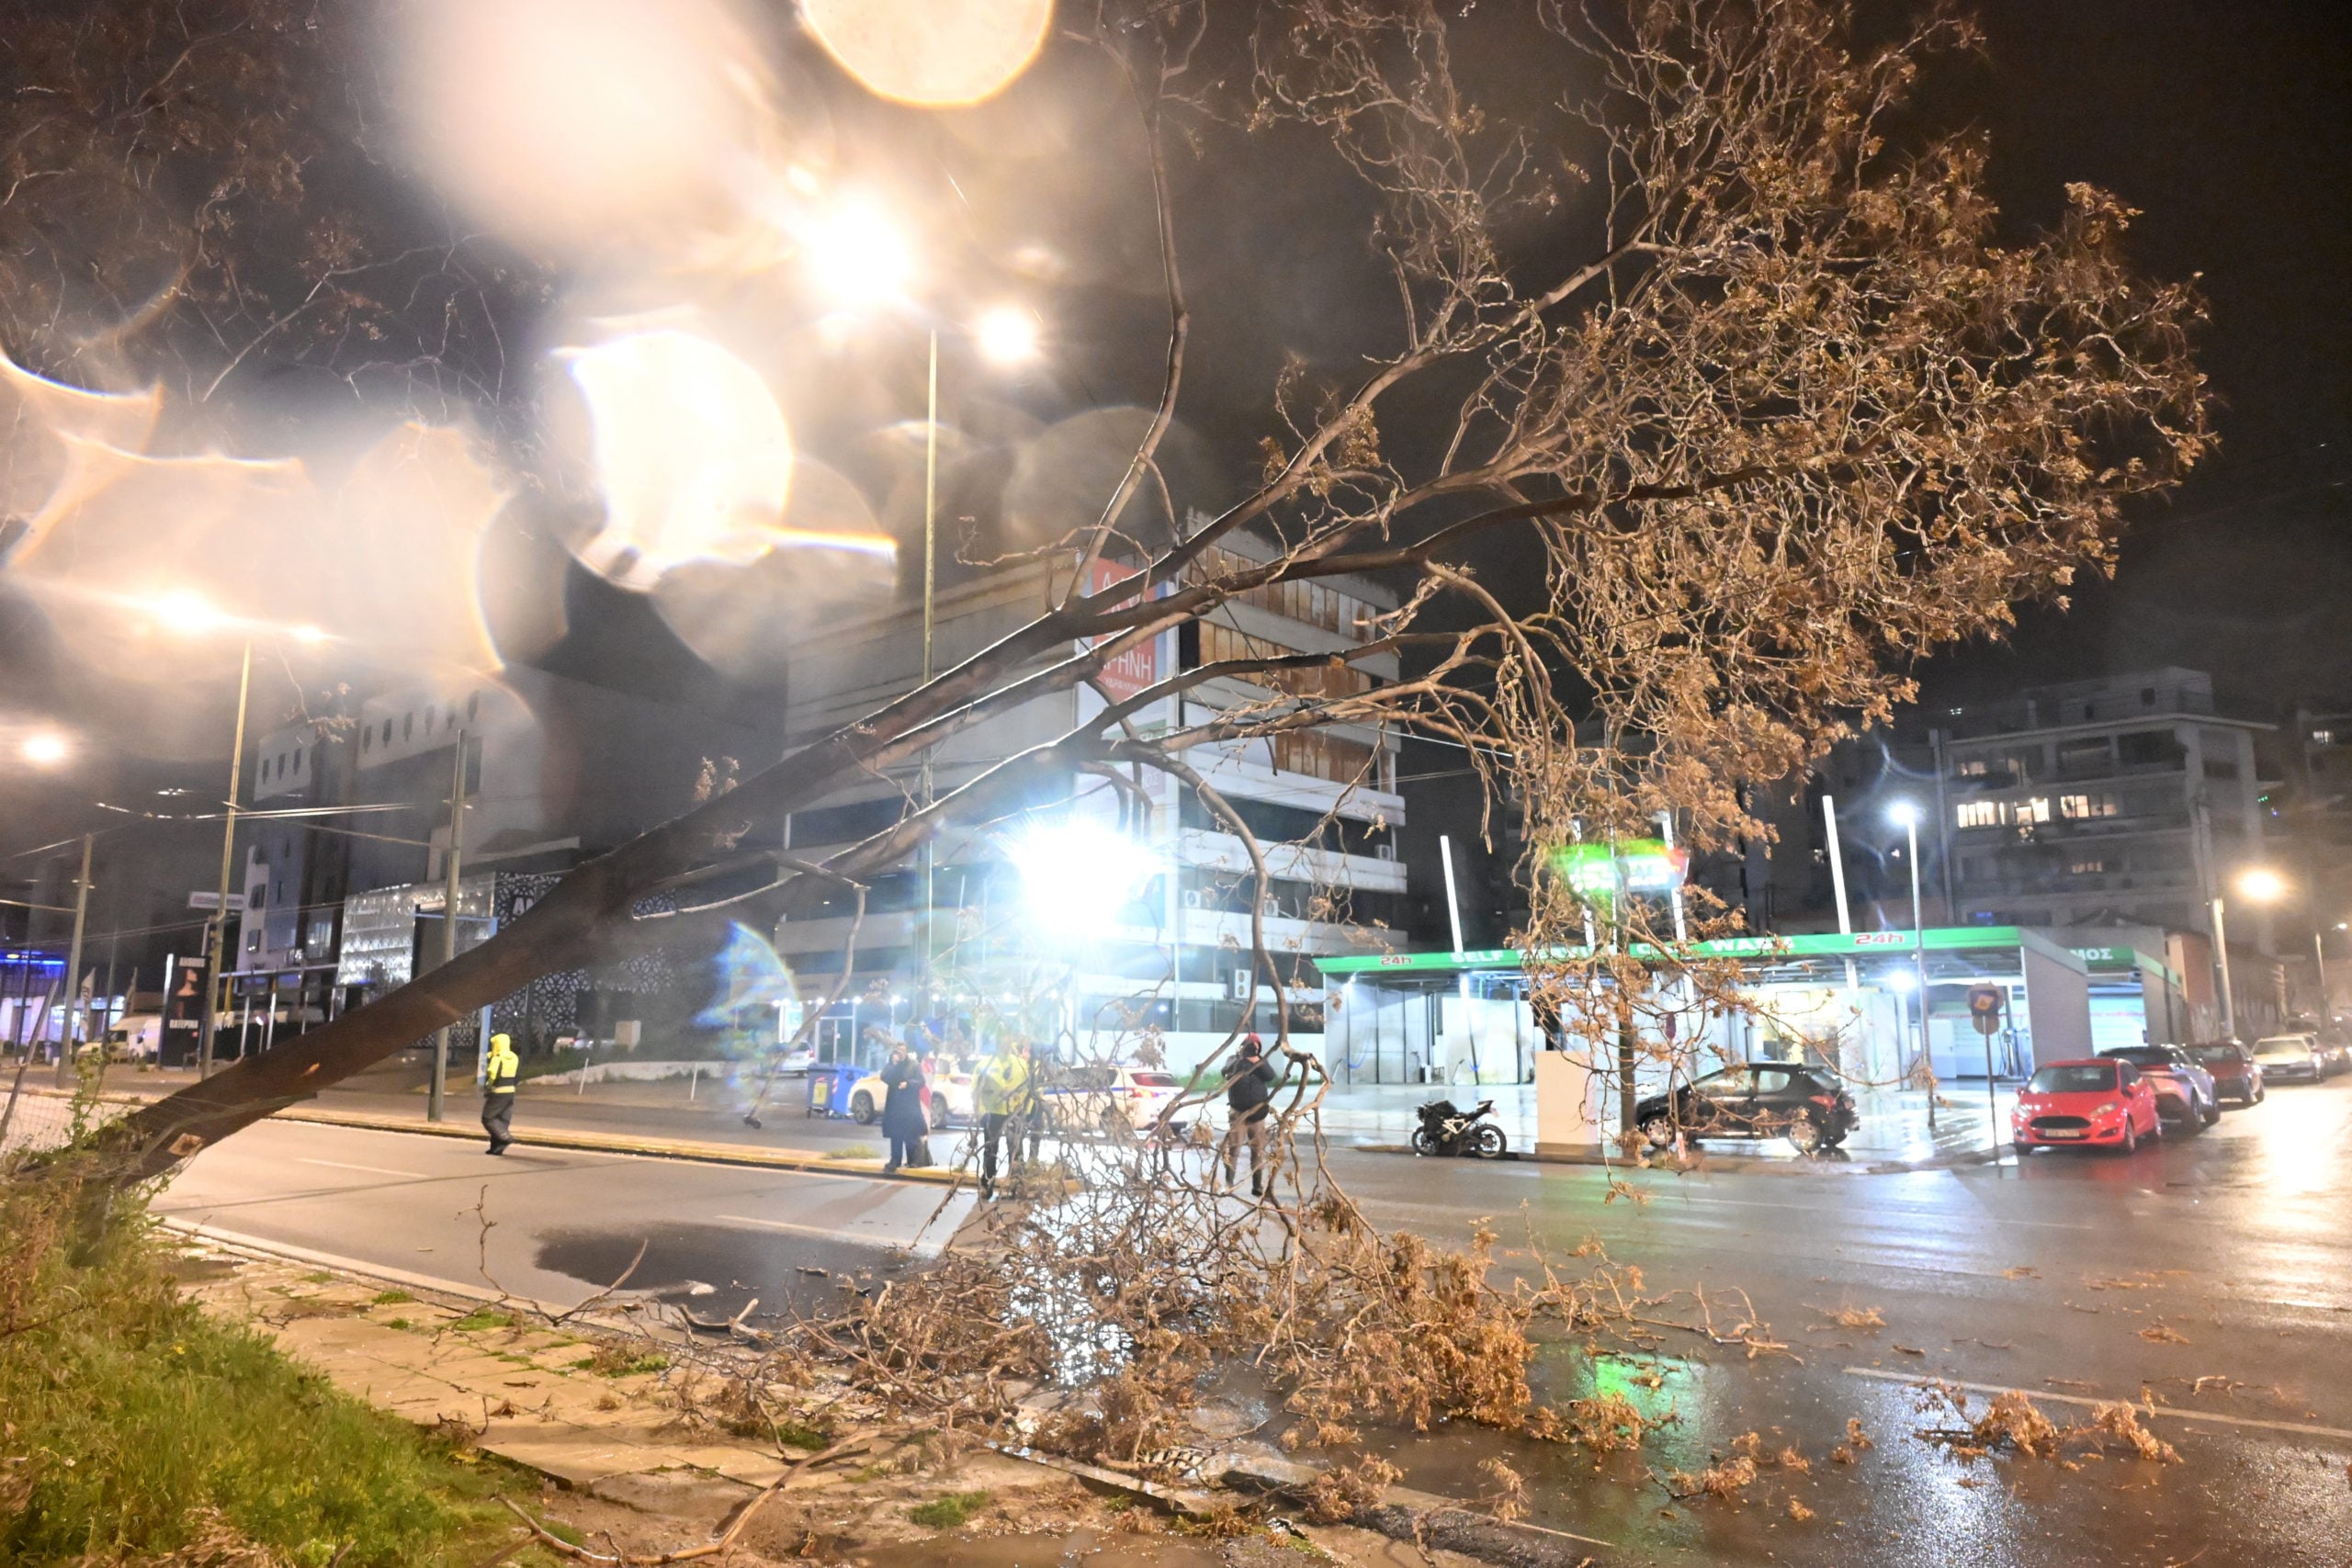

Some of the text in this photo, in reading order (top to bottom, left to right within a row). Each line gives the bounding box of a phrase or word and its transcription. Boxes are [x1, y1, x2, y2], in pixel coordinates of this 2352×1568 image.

[1855, 932, 1904, 945] 24h
[1380, 955, 1412, 965] 24h
[1451, 950, 1504, 963] SELF
